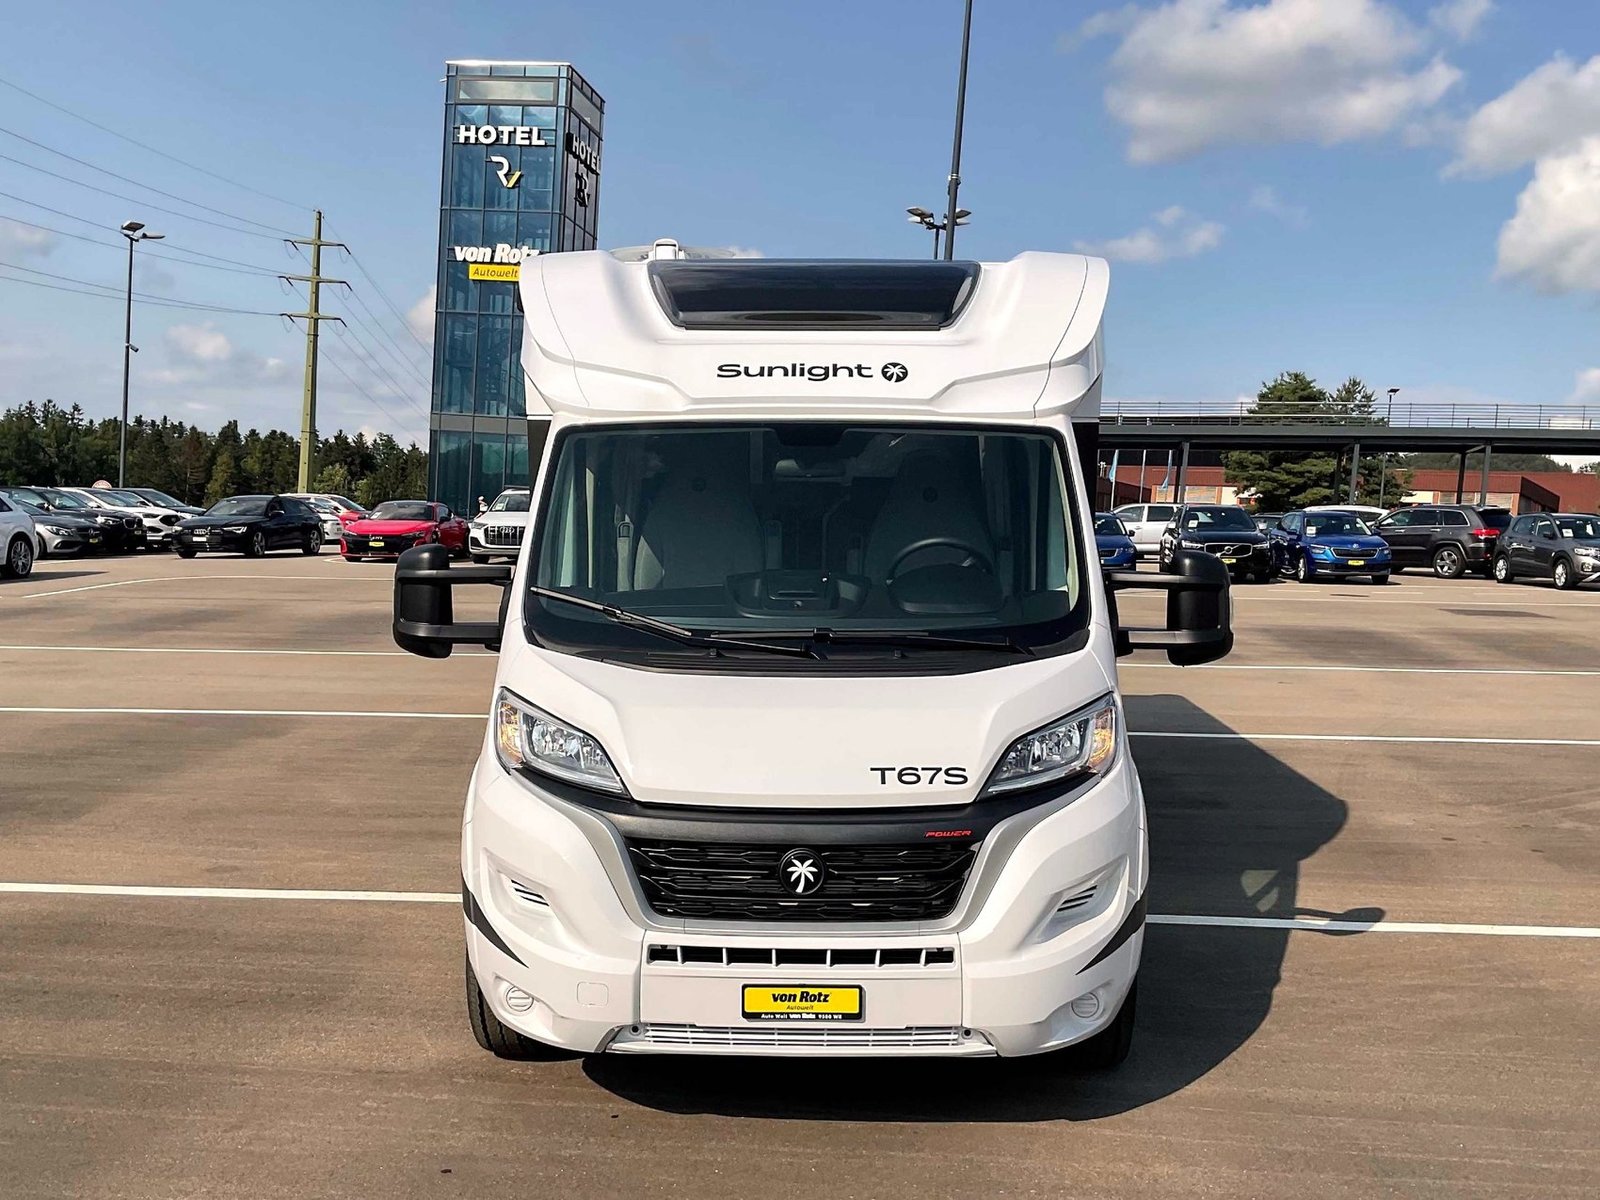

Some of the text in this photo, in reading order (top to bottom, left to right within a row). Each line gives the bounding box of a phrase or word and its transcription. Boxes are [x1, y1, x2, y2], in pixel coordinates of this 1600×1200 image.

[458, 124, 546, 146] HOTEL
[572, 134, 600, 174] HOTEL
[454, 245, 493, 263] von
[473, 267, 518, 278] Autowelt
[717, 363, 873, 381] Sunlight
[870, 766, 968, 785] T67S
[925, 830, 972, 838] POWER
[772, 991, 830, 1002] von Rotz
